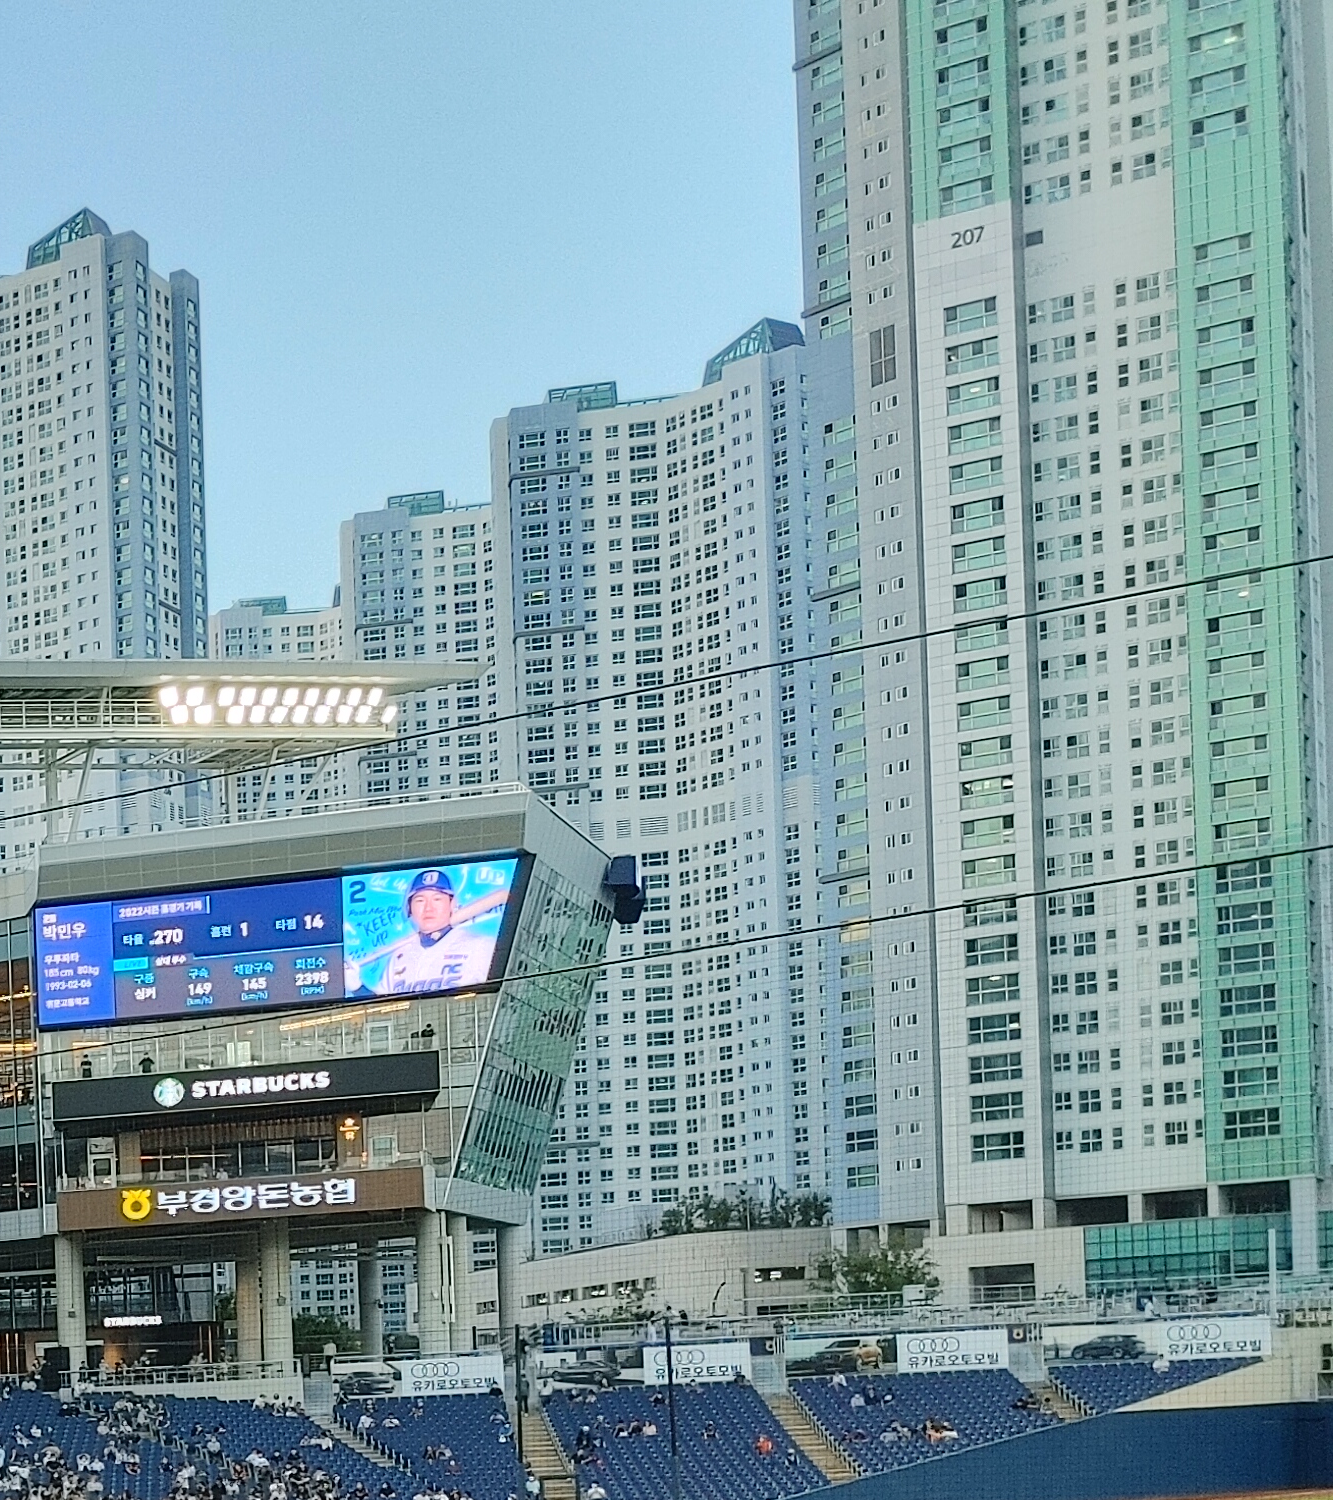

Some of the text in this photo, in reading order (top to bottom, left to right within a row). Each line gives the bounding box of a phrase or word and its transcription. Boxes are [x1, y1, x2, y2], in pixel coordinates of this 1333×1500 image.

[951, 226, 986, 250] 207
[477, 869, 504, 884] UP
[349, 880, 367, 904] 2
[210, 922, 248, 938] 홈런 1
[275, 914, 324, 931] 타점 14
[43, 922, 87, 941] 박민우
[122, 928, 183, 946] 타율 .270
[134, 972, 154, 984] 구종
[188, 967, 210, 979] 구속
[188, 982, 212, 996] 149
[191, 1071, 331, 1100] STARBUCKS
[156, 1177, 357, 1217] 부경양돈농협
[1168, 1339, 1262, 1355] 유카로오토모빌
[908, 1352, 1000, 1368] 유카로오토모빌
[412, 1377, 495, 1392] 유카로오토모빌
